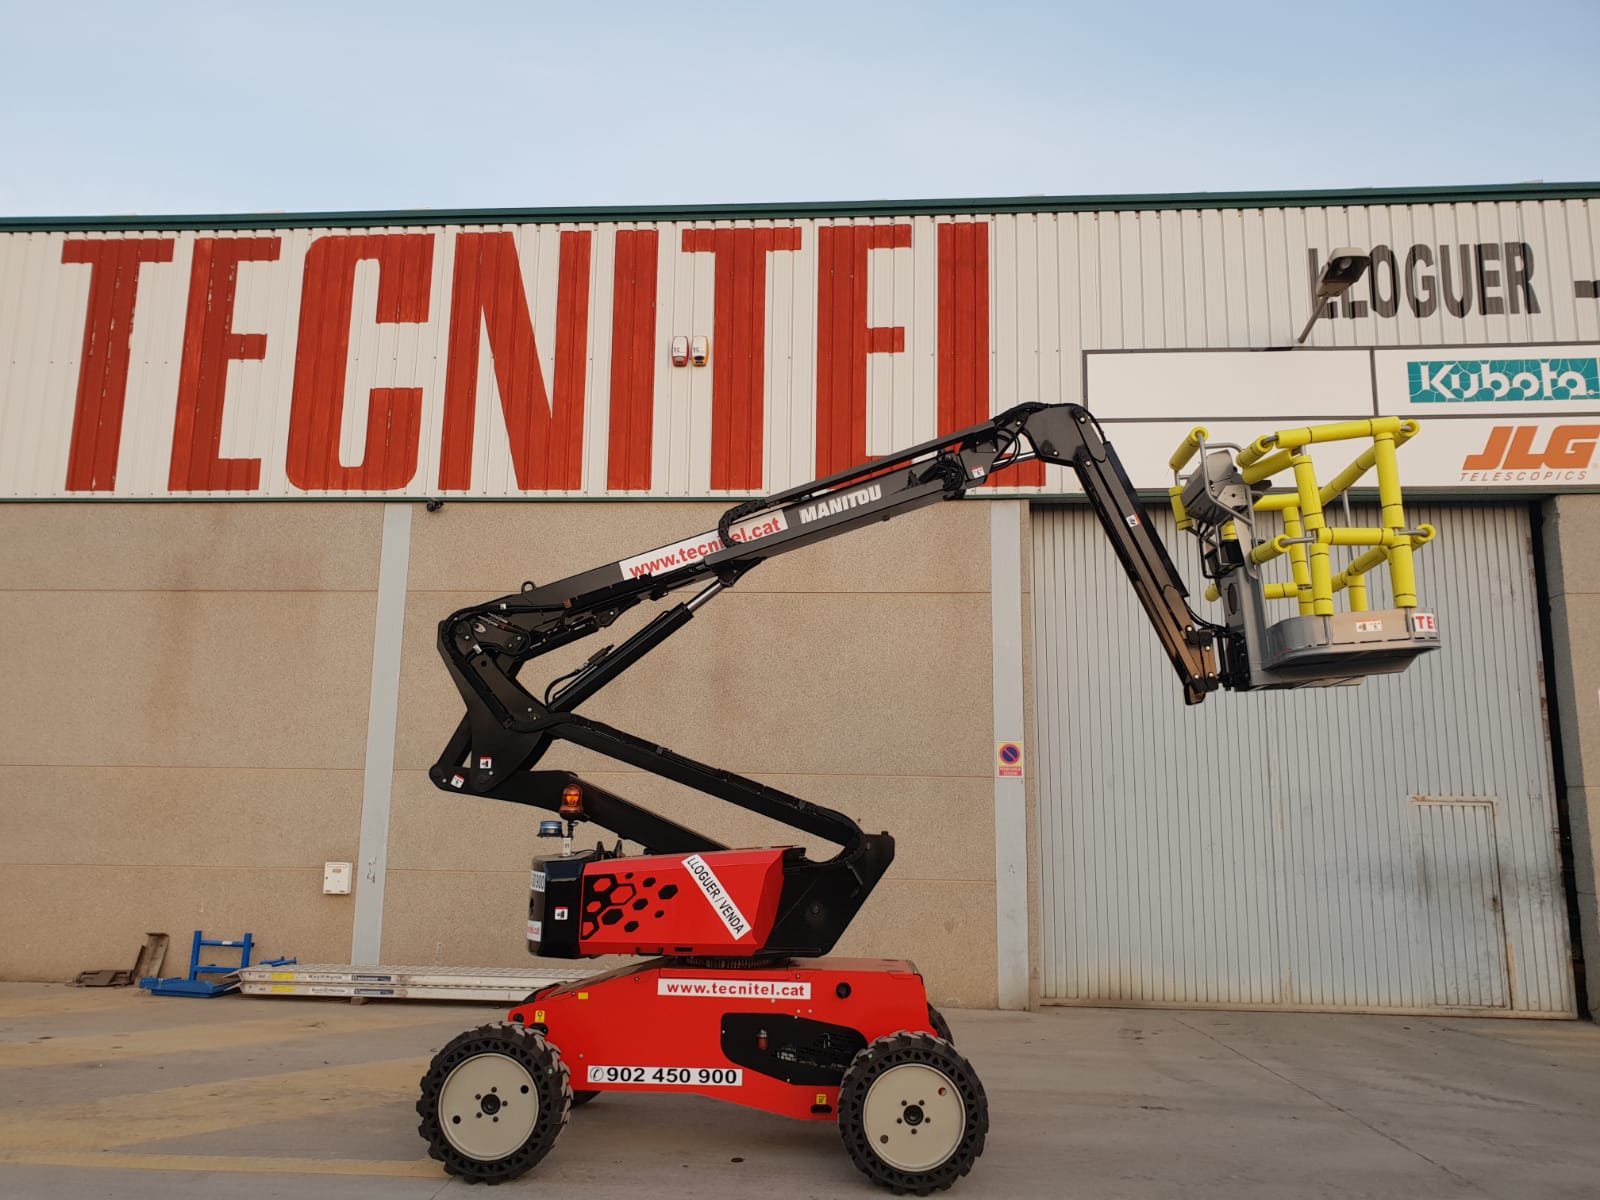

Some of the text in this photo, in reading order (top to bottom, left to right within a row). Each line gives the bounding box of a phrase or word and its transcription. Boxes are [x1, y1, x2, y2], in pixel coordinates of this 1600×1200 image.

[1420, 362, 1588, 399] Kubota
[1462, 425, 1600, 470] JLG
[1459, 470, 1587, 482] TELESCOPICS
[799, 484, 882, 524] MANITOU
[629, 517, 781, 577] www.tecniel.cat
[1415, 615, 1438, 630] TE
[687, 857, 721, 899] LLOGUER
[719, 899, 744, 934] VENDA
[667, 983, 805, 997] www.tecnitel.cat
[607, 1067, 737, 1084] 902 450 900
